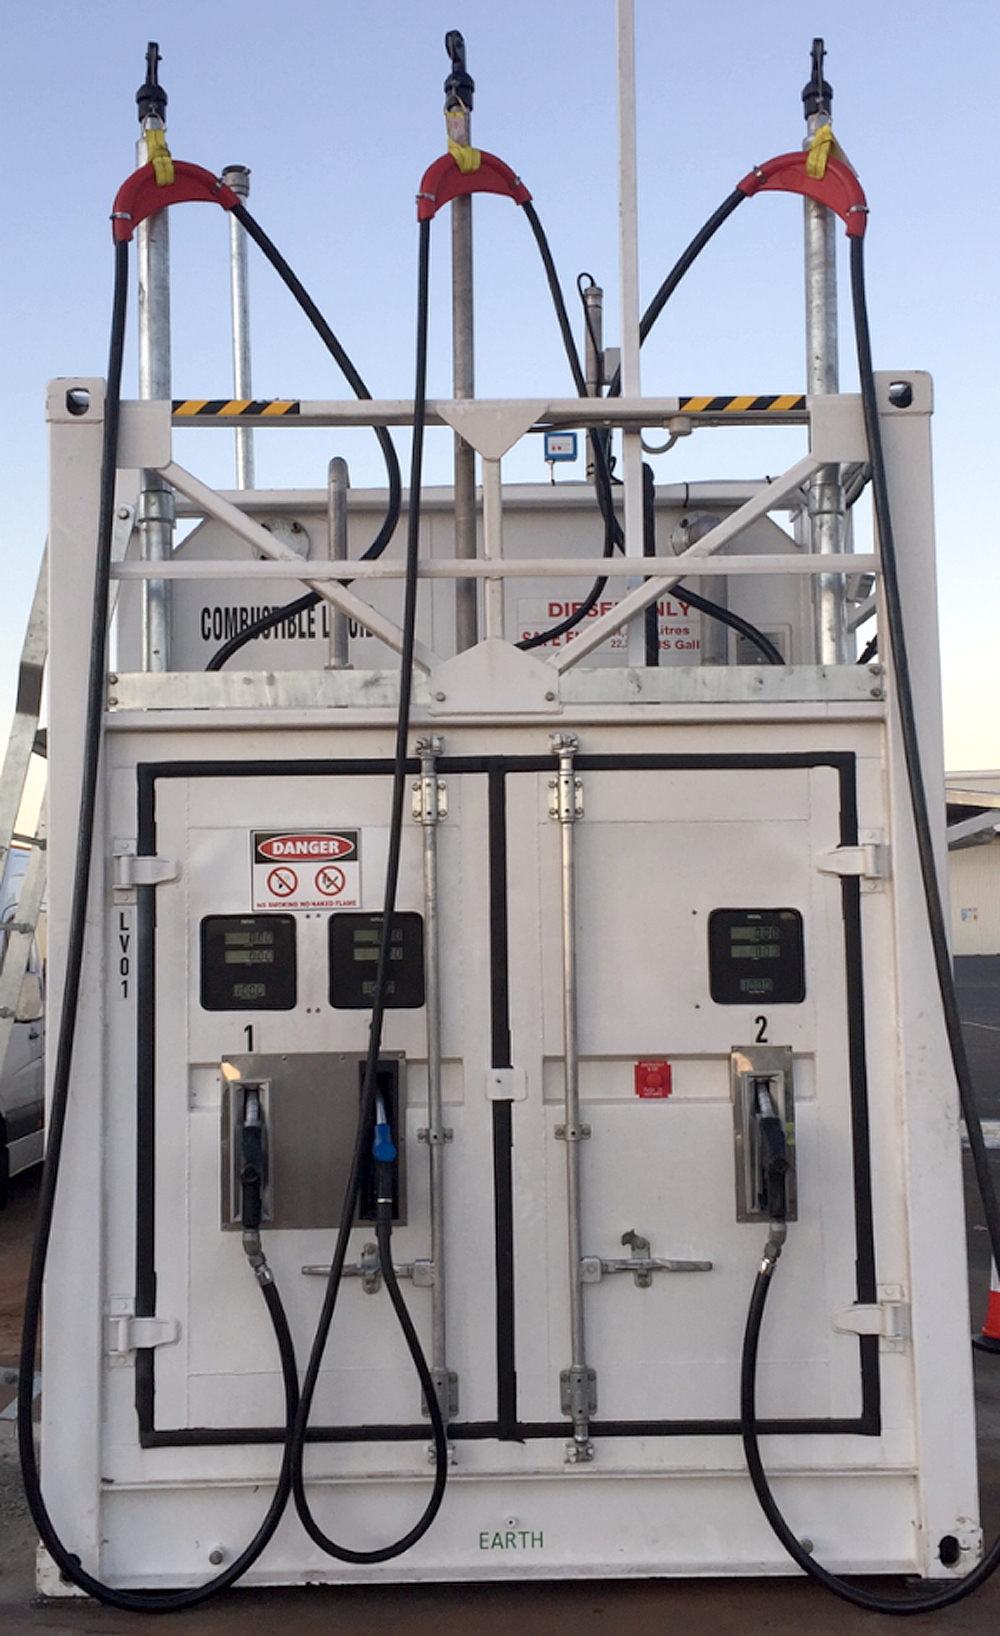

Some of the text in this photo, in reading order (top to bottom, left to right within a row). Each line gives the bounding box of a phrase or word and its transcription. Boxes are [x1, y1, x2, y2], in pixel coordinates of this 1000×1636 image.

[548, 601, 691, 617] DIESE NLY
[659, 625, 690, 636] itres
[674, 639, 700, 650] Gall
[272, 840, 340, 855] DANGER
[755, 1015, 768, 1043] 2
[244, 1024, 254, 1052] 1
[479, 1531, 543, 1550] EARTH
